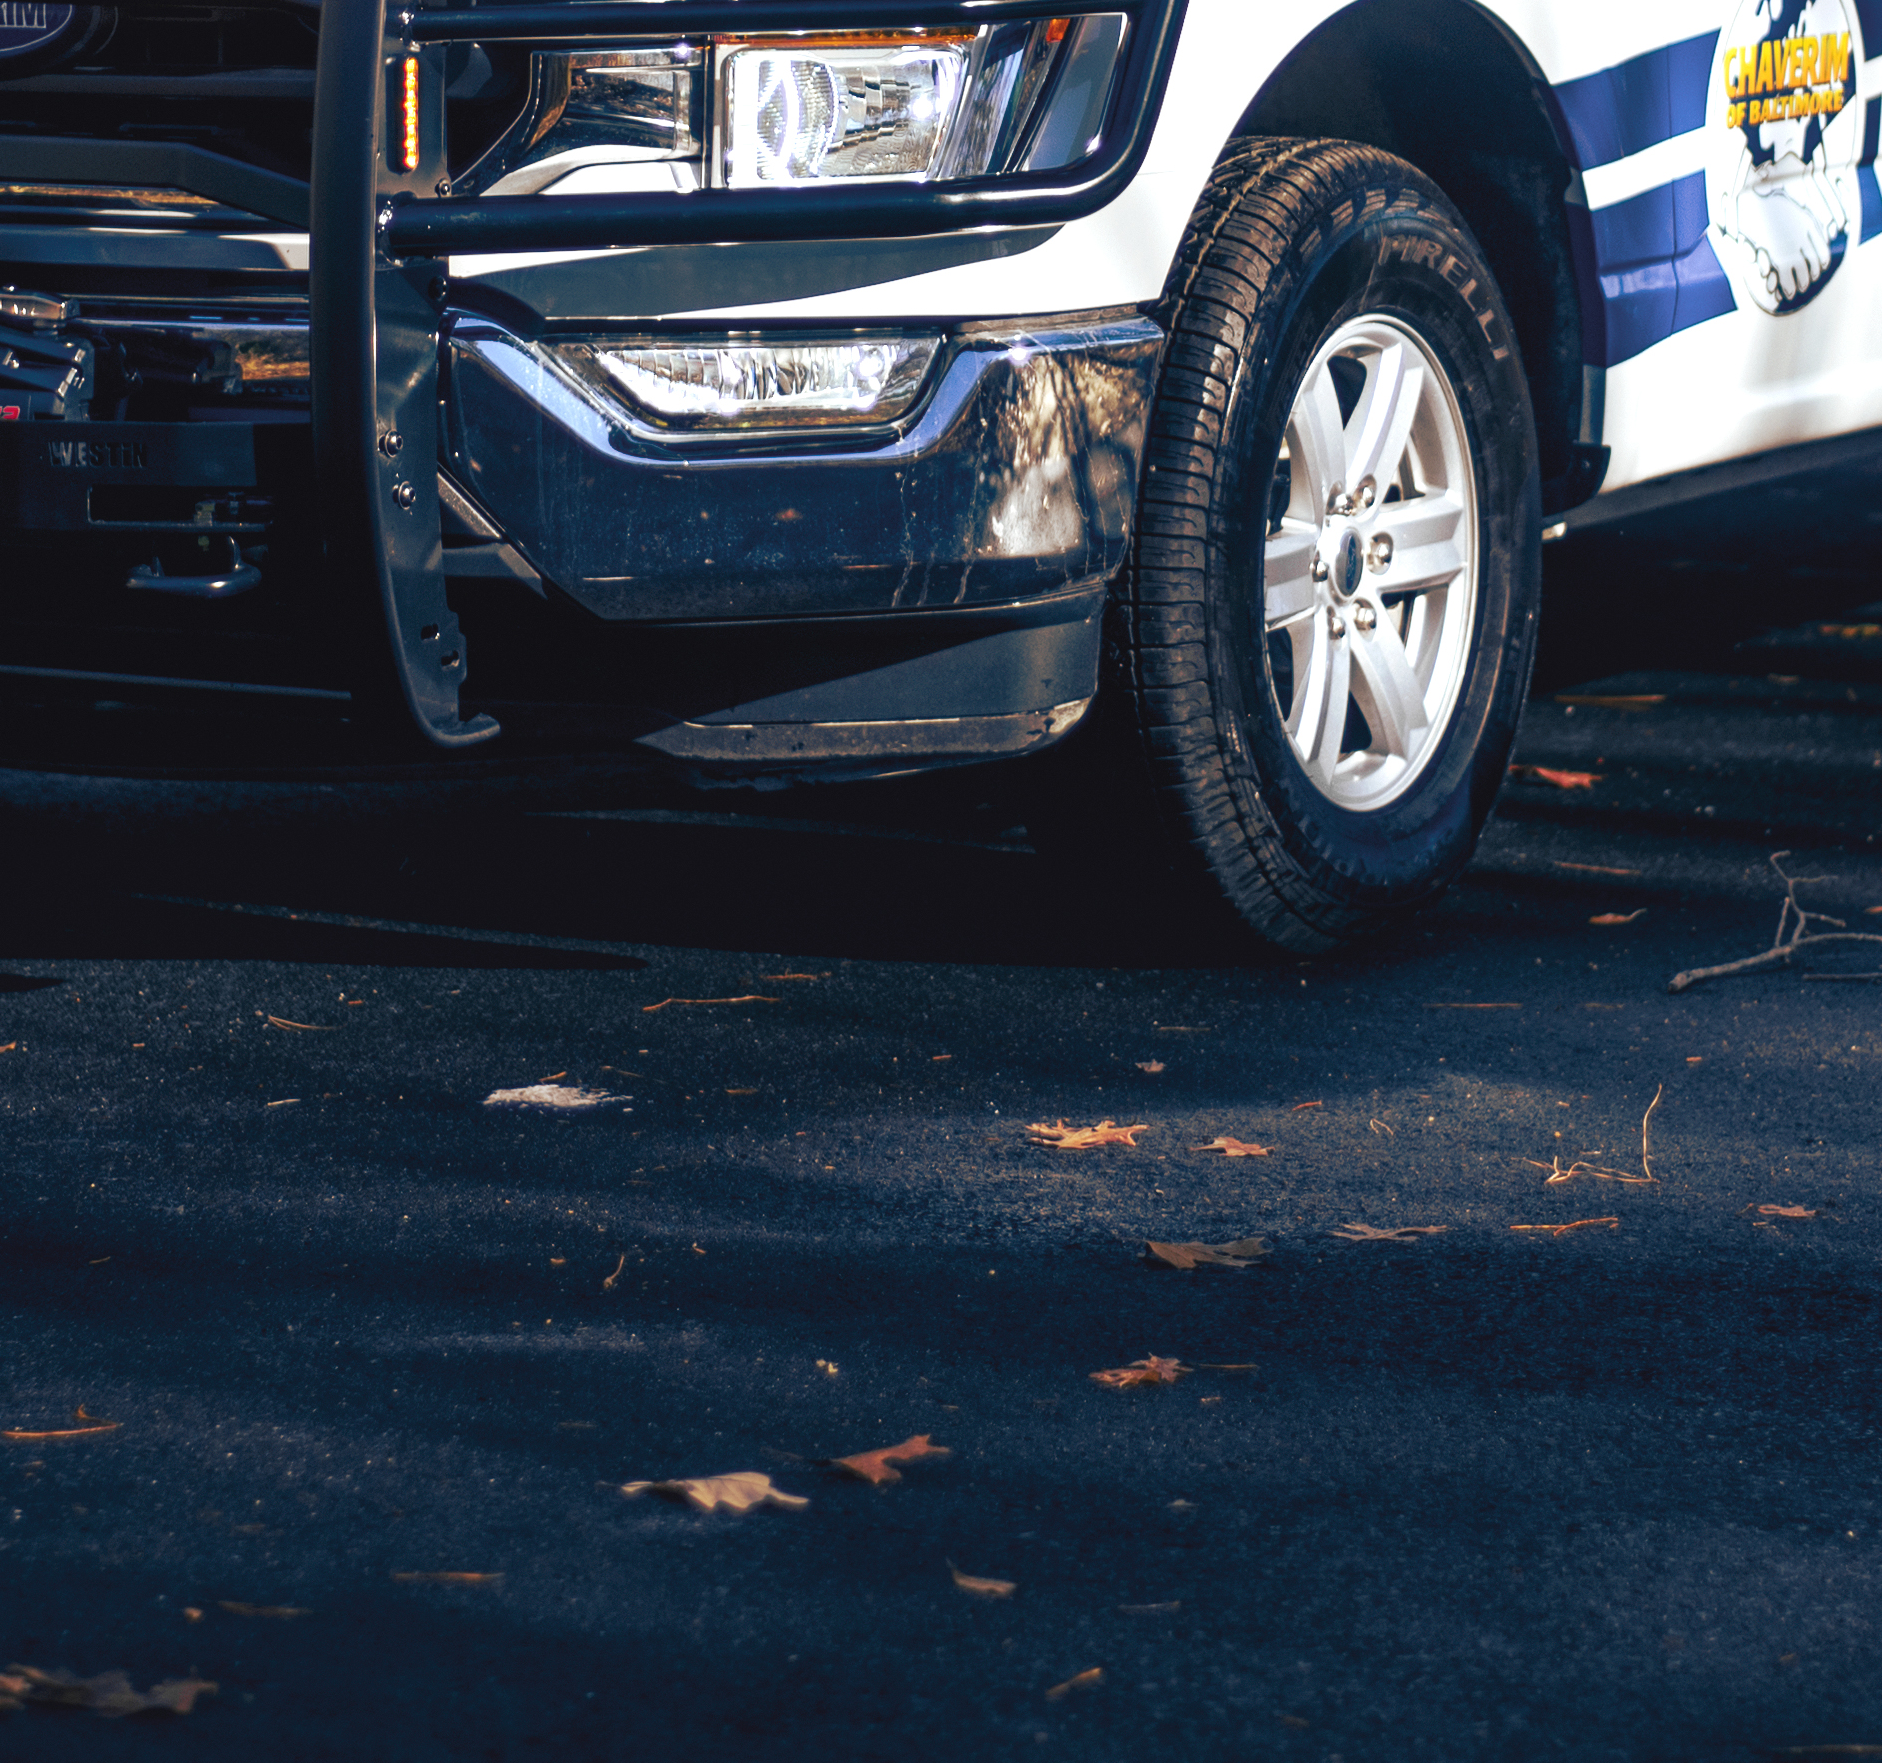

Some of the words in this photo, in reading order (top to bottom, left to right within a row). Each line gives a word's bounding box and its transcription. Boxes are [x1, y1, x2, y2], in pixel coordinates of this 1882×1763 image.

[1723, 32, 1851, 99] CHAVERIM
[1726, 101, 1747, 129] OF
[1749, 88, 1845, 125] BALTIMORE
[1377, 233, 1510, 362] PIRELLI
